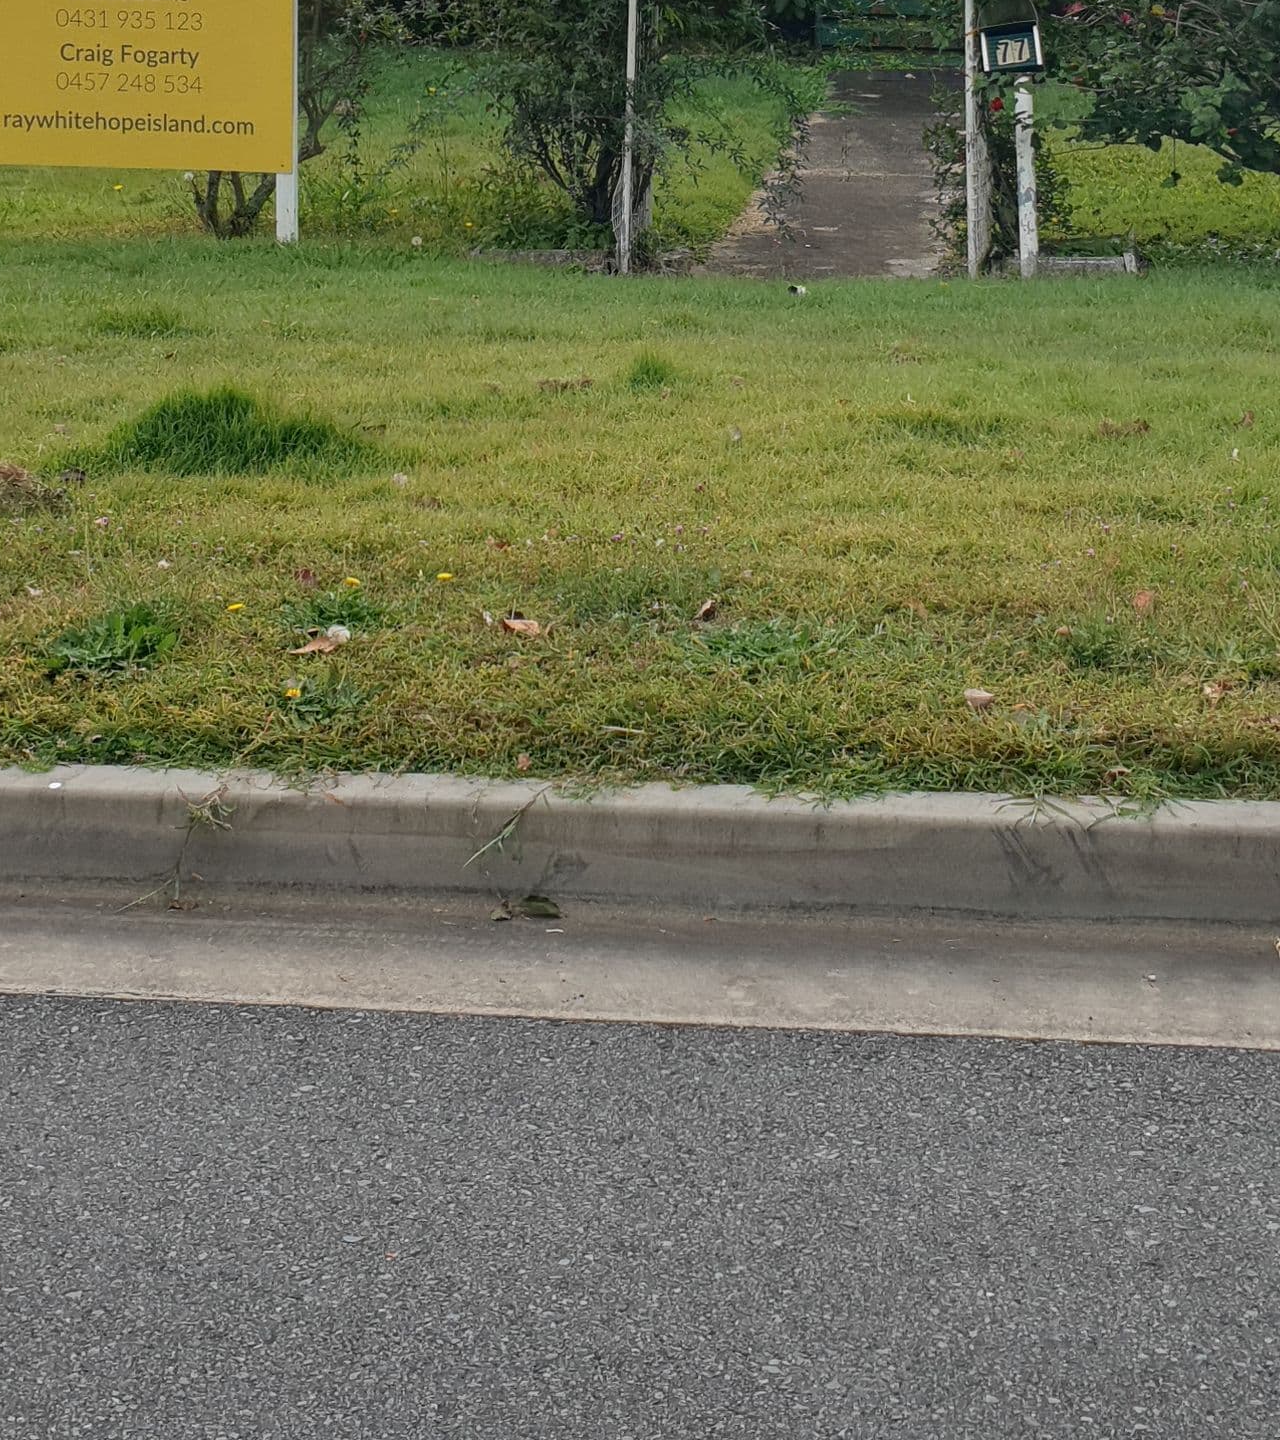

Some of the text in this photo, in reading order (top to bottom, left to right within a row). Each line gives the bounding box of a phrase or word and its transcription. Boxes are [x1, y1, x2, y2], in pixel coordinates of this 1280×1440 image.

[55, 8, 203, 31] 0431 935 123
[59, 43, 200, 68] Craig Fogarty
[997, 40, 1025, 63] 77
[55, 71, 203, 94] 0457 248 534
[3, 110, 255, 136] raywhitehopeisland.com
